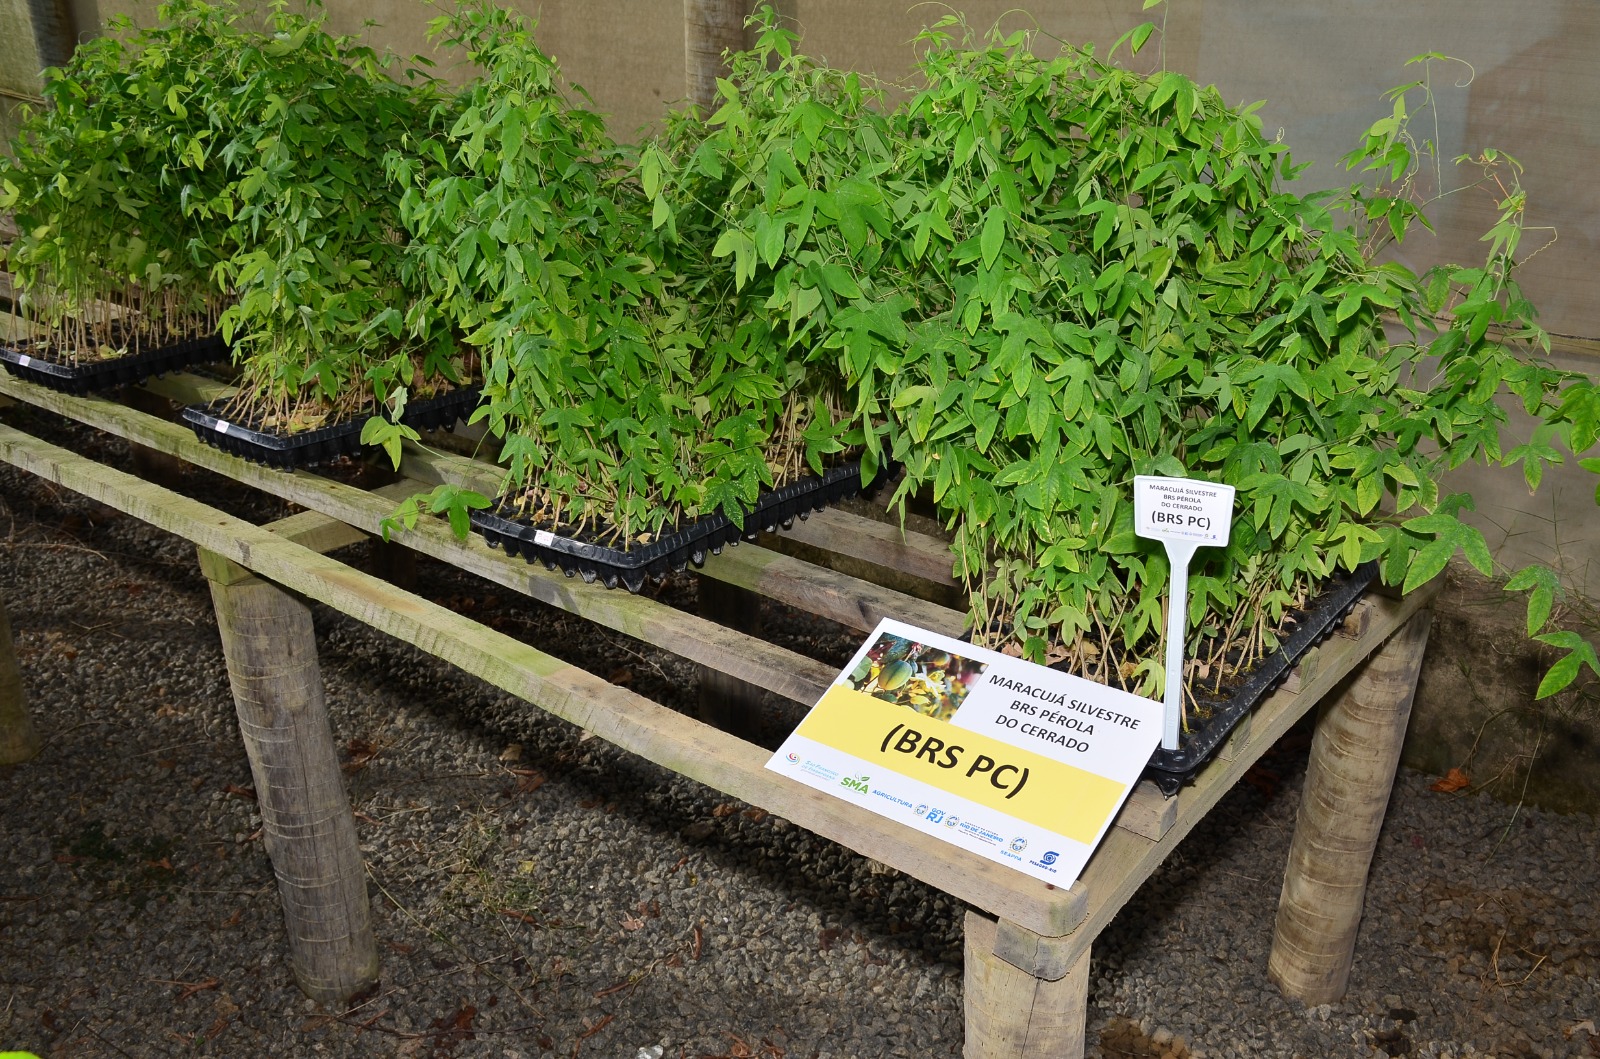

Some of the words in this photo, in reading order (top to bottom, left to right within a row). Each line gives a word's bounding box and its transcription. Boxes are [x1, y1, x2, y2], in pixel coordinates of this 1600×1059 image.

[1149, 484, 1184, 494] MARACUJÁ
[1185, 488, 1217, 497] SILVESTRE
[1176, 494, 1201, 504] PÉROLA
[1172, 503, 1203, 512] CERRADO
[1151, 510, 1183, 525] (BRS
[1187, 516, 1211, 531] PC)
[989, 674, 1068, 706] MARACUJÁ
[1067, 699, 1141, 730] SILVESTRE
[1010, 700, 1039, 716] BRS
[1039, 709, 1094, 735] PÉROLA
[995, 714, 1019, 729] DO
[1020, 723, 1090, 753] CERRADO
[880, 723, 965, 769] (BRS
[965, 754, 1030, 800] PC)
[840, 777, 869, 795] SMA
[872, 789, 913, 809] AGRICULTURA
[925, 811, 944, 824] RJ
[931, 807, 946, 816] GOV
[959, 822, 971, 831] RIO
[979, 829, 1004, 843] JANEIRO
